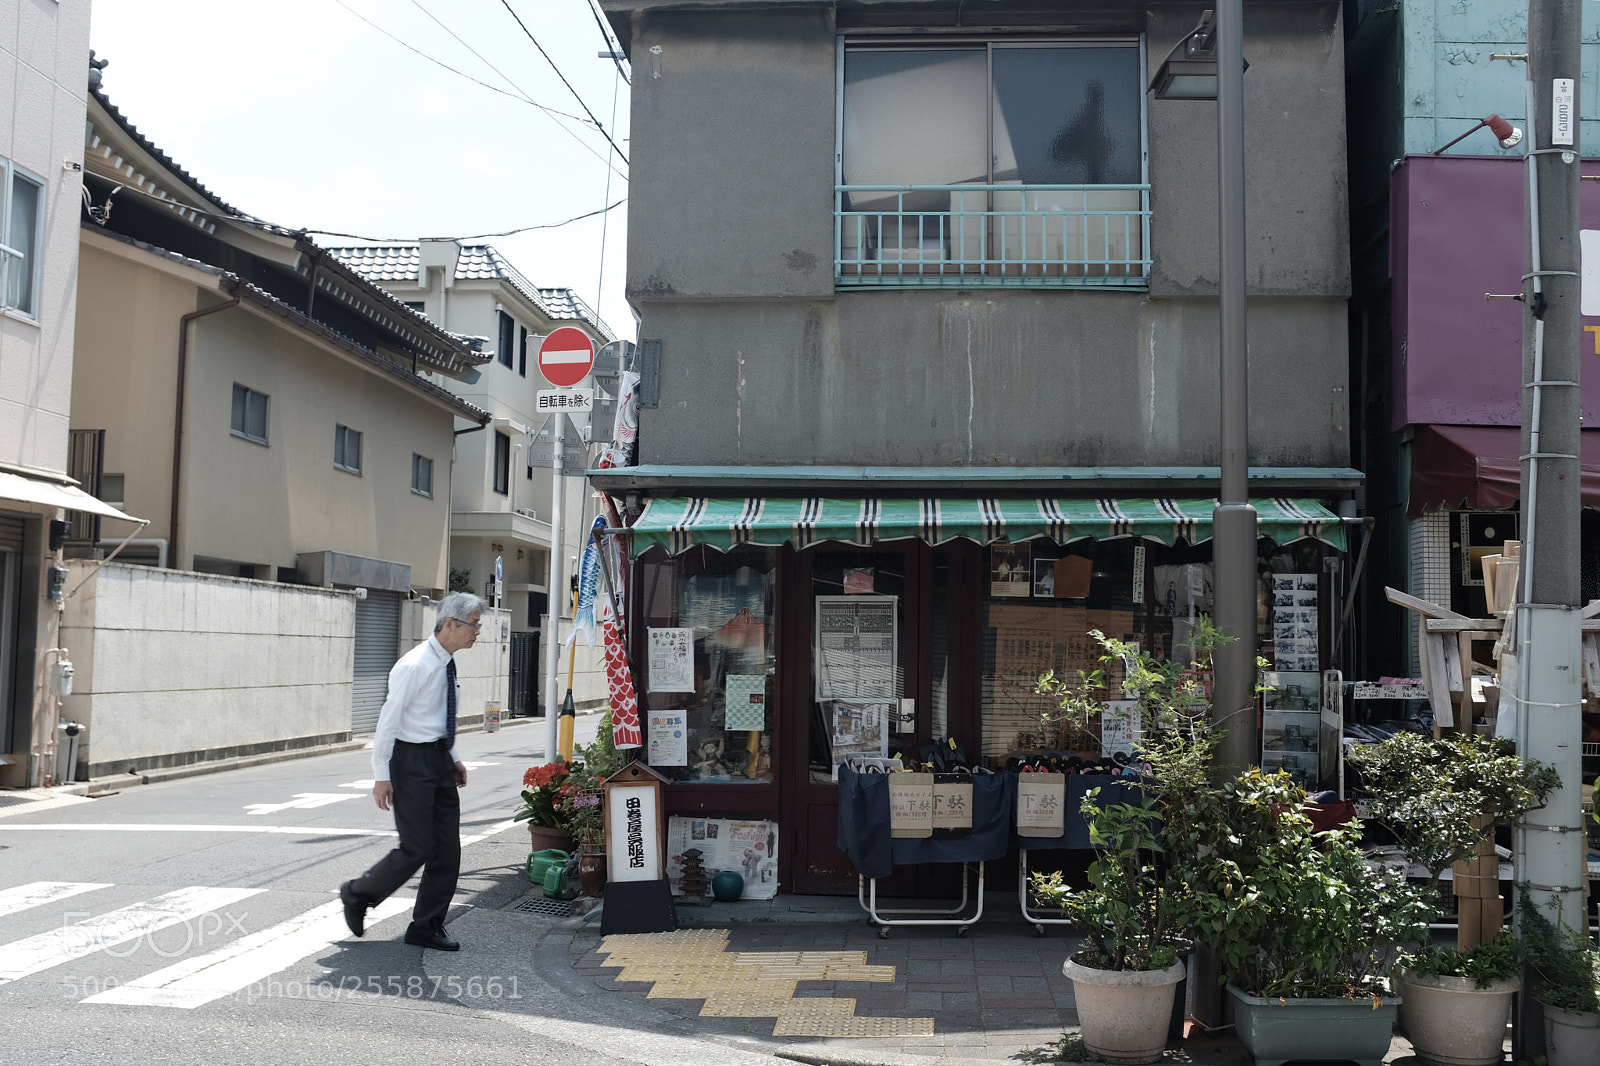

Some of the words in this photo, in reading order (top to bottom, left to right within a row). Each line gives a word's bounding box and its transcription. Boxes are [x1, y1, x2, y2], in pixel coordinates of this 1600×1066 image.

[539, 394, 590, 408] 自転車を除く
[1022, 793, 1059, 810] 下駄
[625, 797, 645, 869] 田巻屋呉服店
